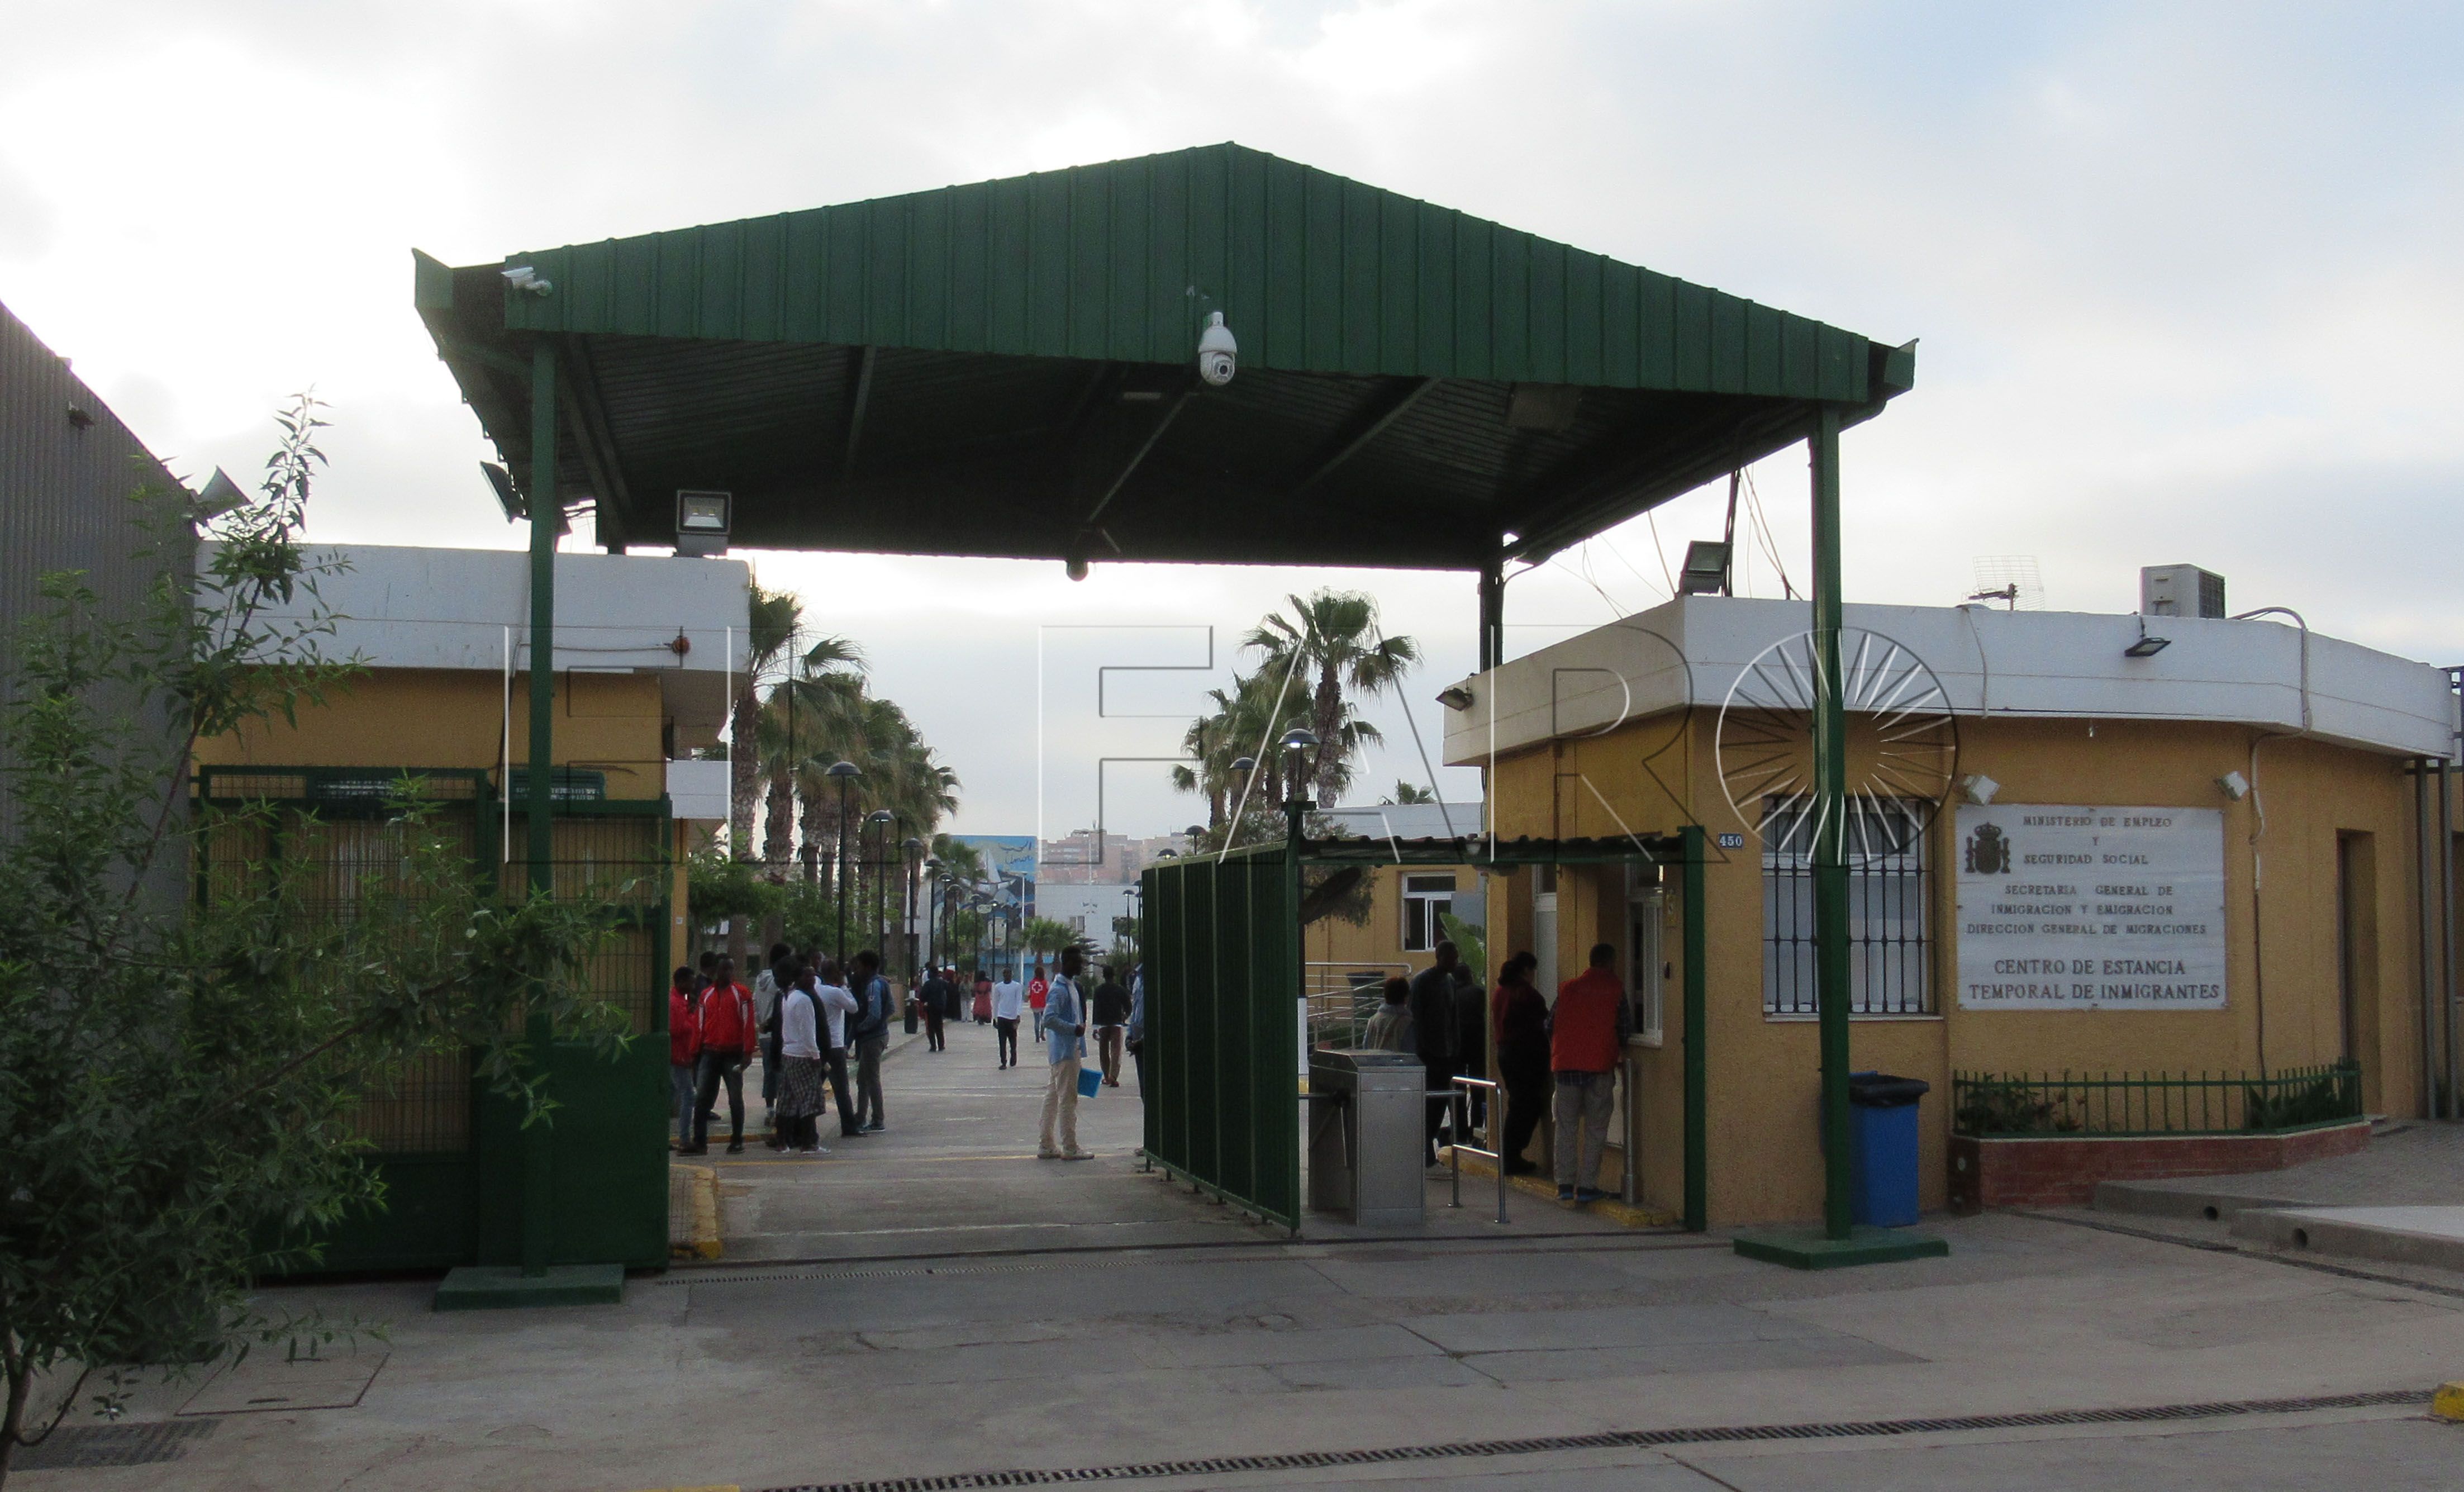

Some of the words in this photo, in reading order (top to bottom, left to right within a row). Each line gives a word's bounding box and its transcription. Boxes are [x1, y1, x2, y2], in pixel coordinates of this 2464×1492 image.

[2023, 816, 2091, 826] MINISTERIO
[2100, 817, 2115, 826] DE
[2124, 818, 2172, 827] EMPLEO
[1719, 835, 1742, 847] 450
[2092, 837, 2099, 846] Y
[2024, 854, 2092, 864] SEGURIDAD
[2103, 854, 2148, 864] SOCIAL
[2005, 885, 2077, 895] SECRETARIA
[2095, 885, 2149, 895] GENERAL
[2158, 886, 2173, 896] DE
[1991, 904, 2071, 914] INMIGRACION
[2081, 905, 2088, 914] Y
[2097, 905, 2173, 915] EMIGRACION
[1967, 924, 2034, 934] DIRECCION
[2041, 924, 2097, 934] GENERAL
[2103, 925, 2117, 934] DE
[2126, 925, 2206, 934] MIGRACIONES
[1995, 959, 2065, 974] CENTRO
[2072, 959, 2094, 975] DE
[2103, 959, 2186, 975] ESTANCIA
[1969, 984, 2065, 999] TEMPORAL
[2072, 984, 2094, 999] DE
[2101, 984, 2219, 1000] INMIGRANTES
